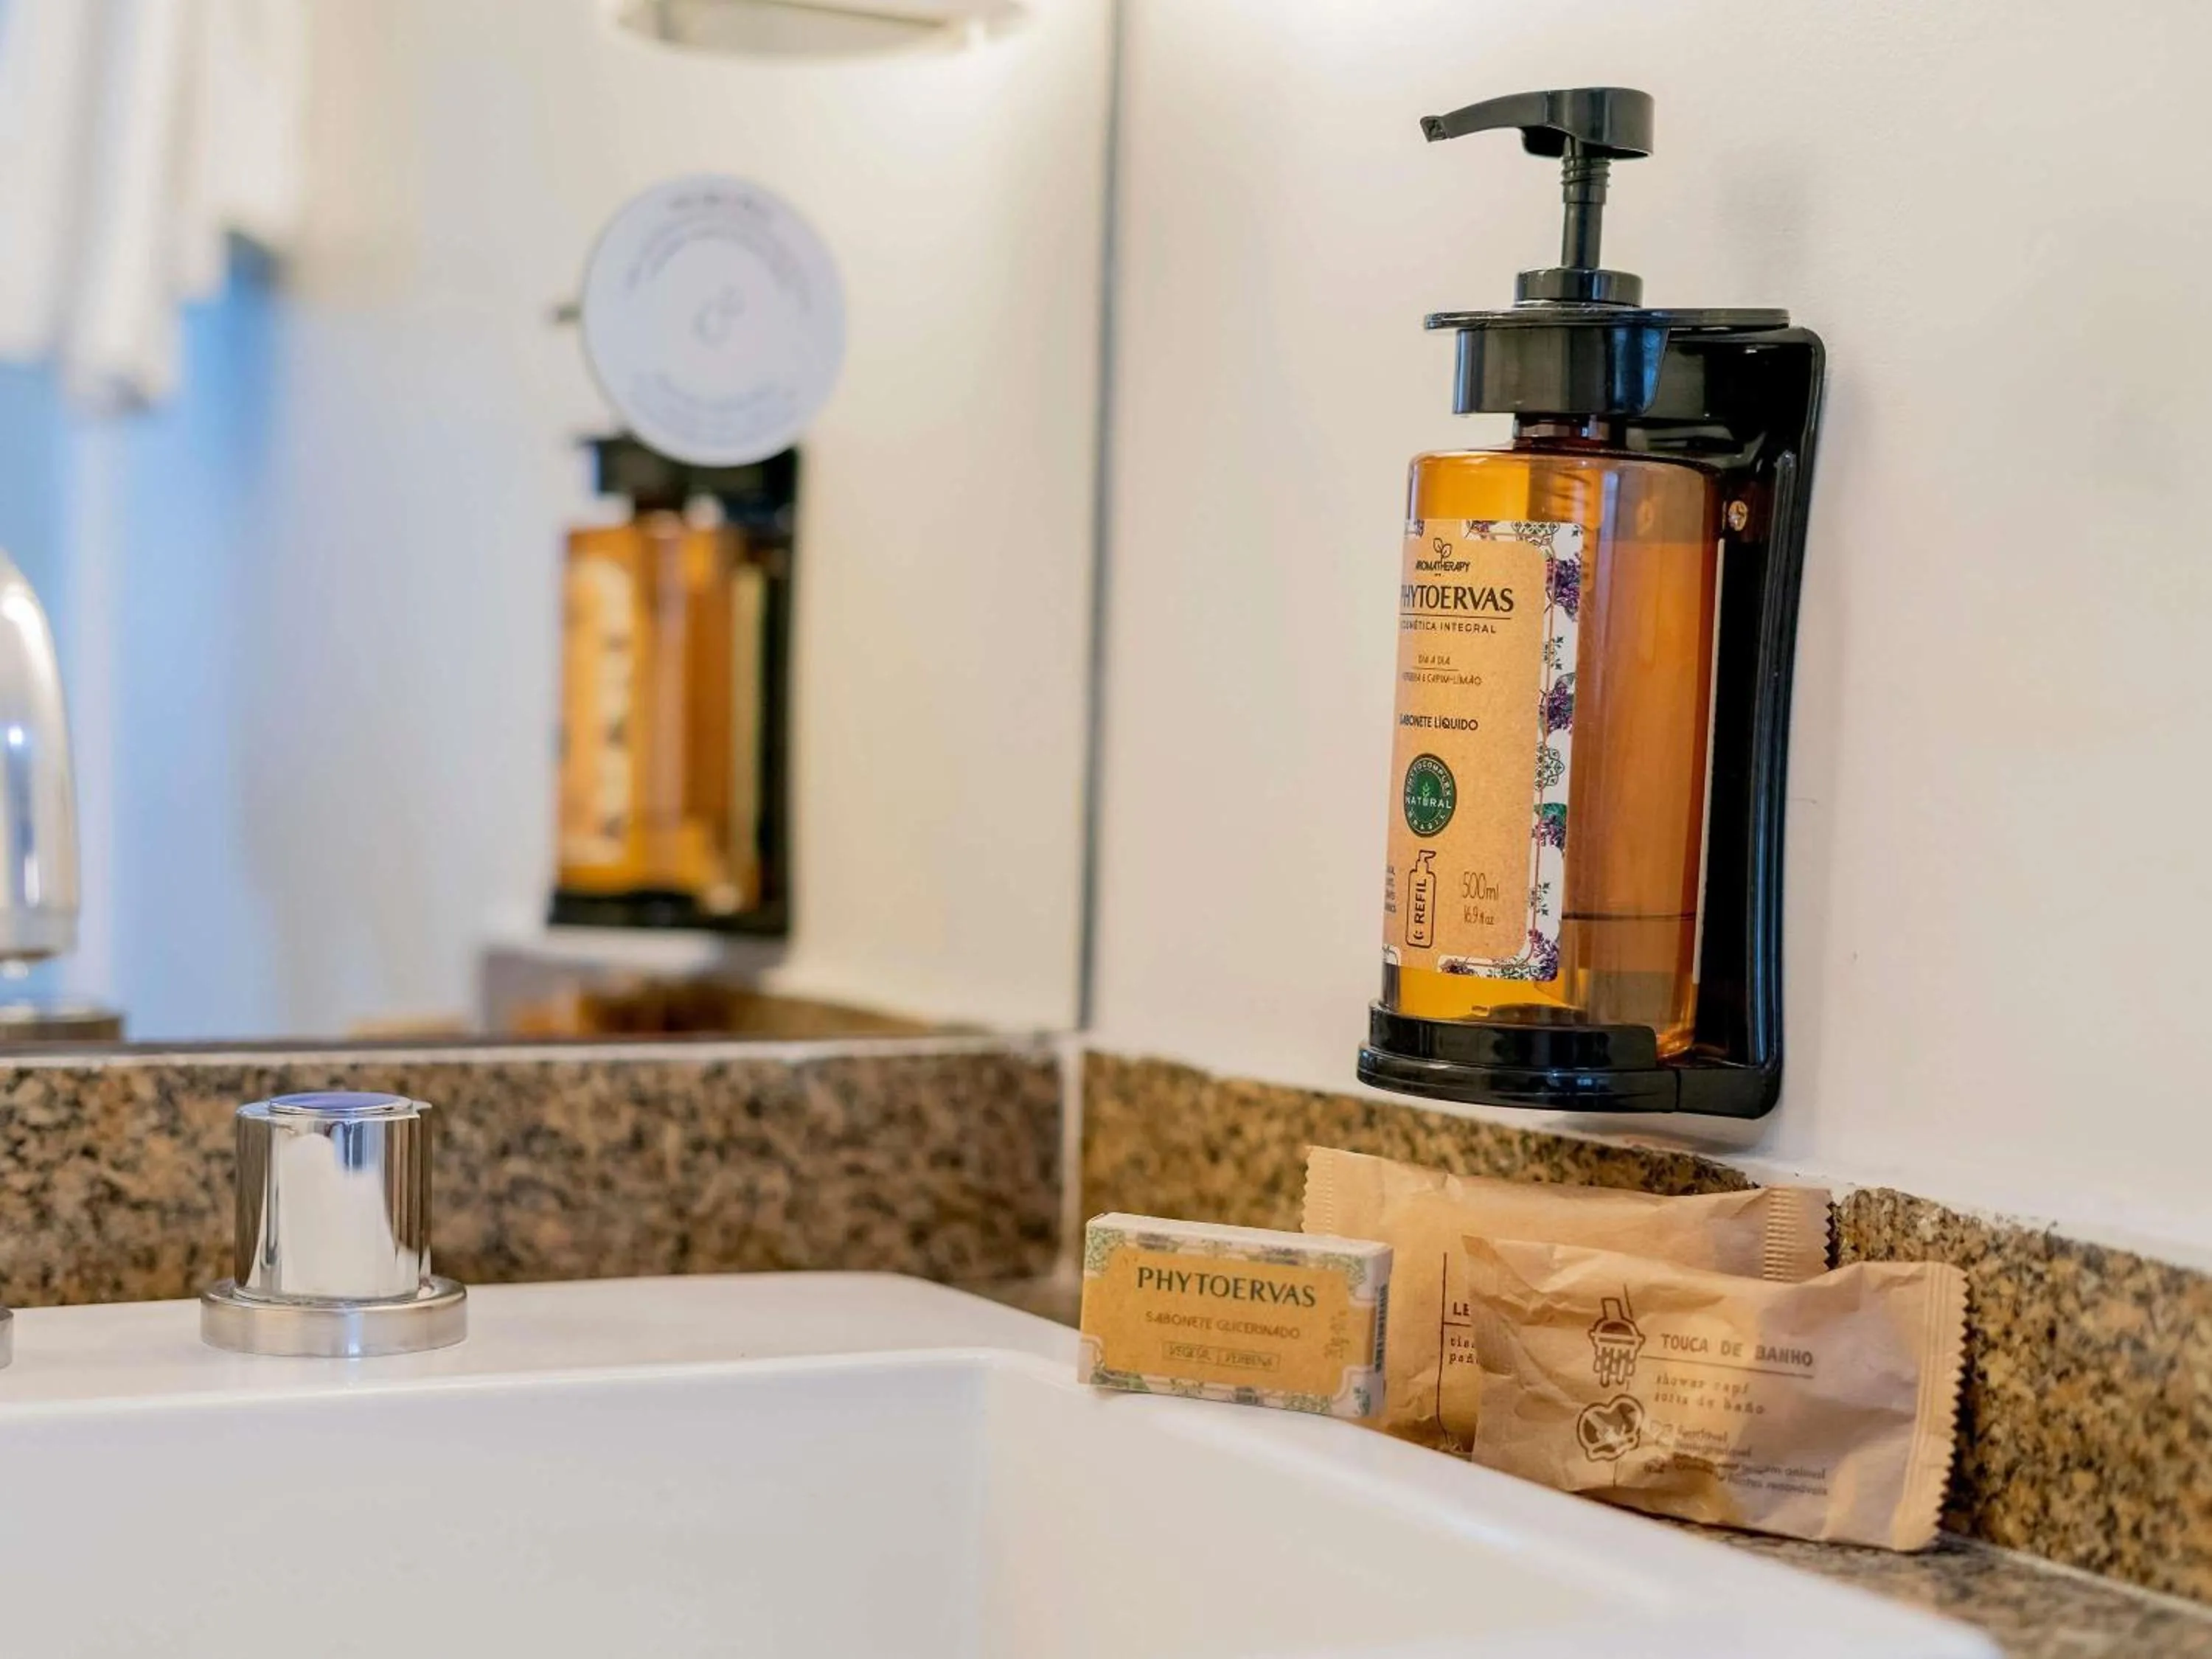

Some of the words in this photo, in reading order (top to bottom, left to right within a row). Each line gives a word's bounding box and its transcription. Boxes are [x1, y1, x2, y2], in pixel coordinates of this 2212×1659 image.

[1441, 622, 1497, 634] INTEGRAL
[1434, 714, 1478, 731] LÍQUIDO
[1405, 796, 1451, 809] NATURAL
[1462, 872, 1499, 900] 500ml
[1414, 879, 1427, 924] REFIL
[1137, 1267, 1316, 1308] PHYTOERVAS
[1453, 1301, 1470, 1316] LE
[1146, 1311, 1212, 1330] SABONETE
[1660, 1333, 1708, 1353] TOUCA
[1721, 1340, 1742, 1358] DE
[1756, 1345, 1814, 1368] BANHO
